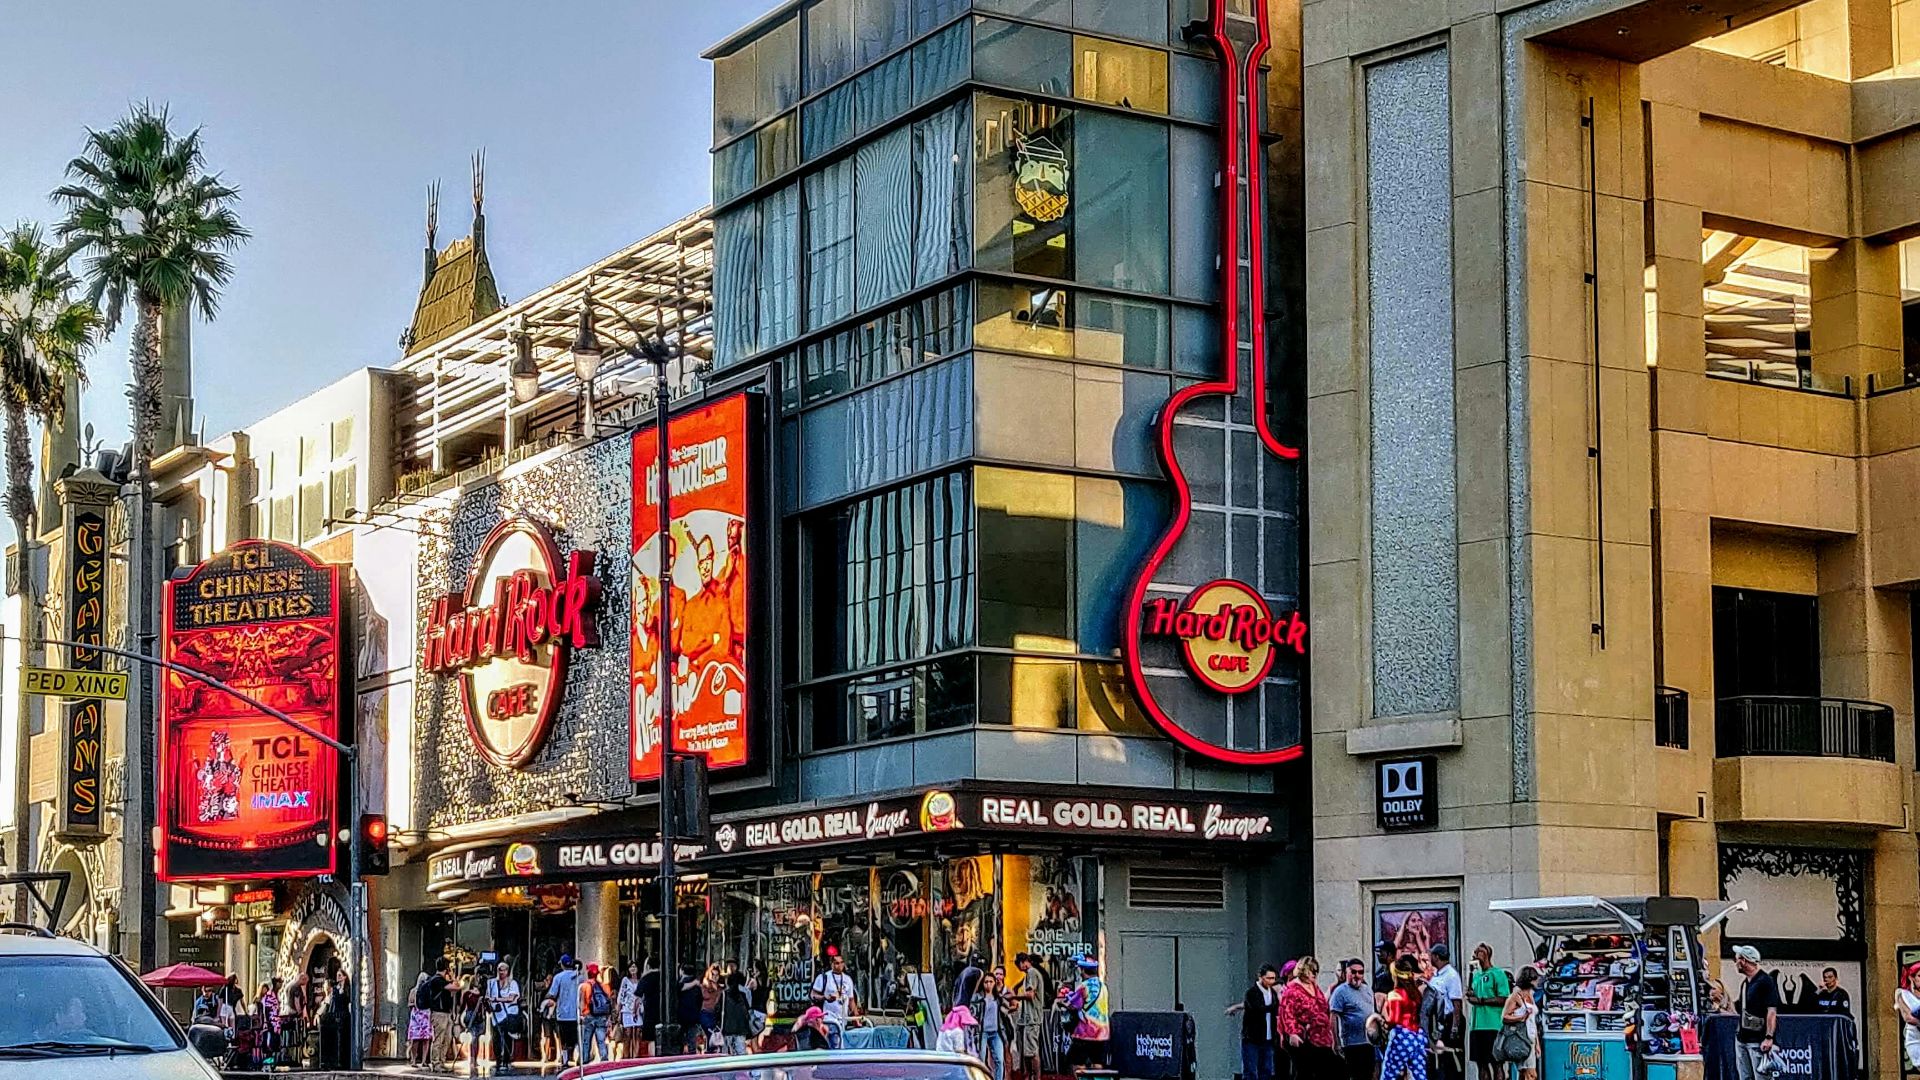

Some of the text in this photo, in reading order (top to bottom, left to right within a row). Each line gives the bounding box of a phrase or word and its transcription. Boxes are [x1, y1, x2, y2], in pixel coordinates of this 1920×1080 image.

[230, 548, 275, 571] TCL
[199, 567, 304, 600] CHINESE
[189, 593, 315, 625] THEATRES
[423, 550, 590, 673] Hard Rock
[1150, 597, 1308, 654] Hard Rock
[74, 522, 103, 814] GRAUANS
[1207, 654, 1250, 673] CAFE
[27, 672, 120, 695] PED XING
[487, 684, 535, 722] CAFE
[252, 735, 310, 760] TCL
[251, 761, 309, 779] CHINESE
[251, 776, 309, 793] THEATRE
[251, 790, 311, 809] IMAX
[1383, 799, 1423, 814] DOLBY
[745, 823, 781, 847] REAL
[824, 811, 862, 837] REAL
[982, 798, 1273, 842] REAL GOLD. REAL Burger.
[443, 857, 463, 877] REAL
[558, 845, 607, 868] REAL
[317, 873, 334, 884] TCL
[1026, 942, 1093, 955] TOGETHER
[777, 982, 812, 1001] TOGE
[1136, 1034, 1172, 1047] Hollywood
